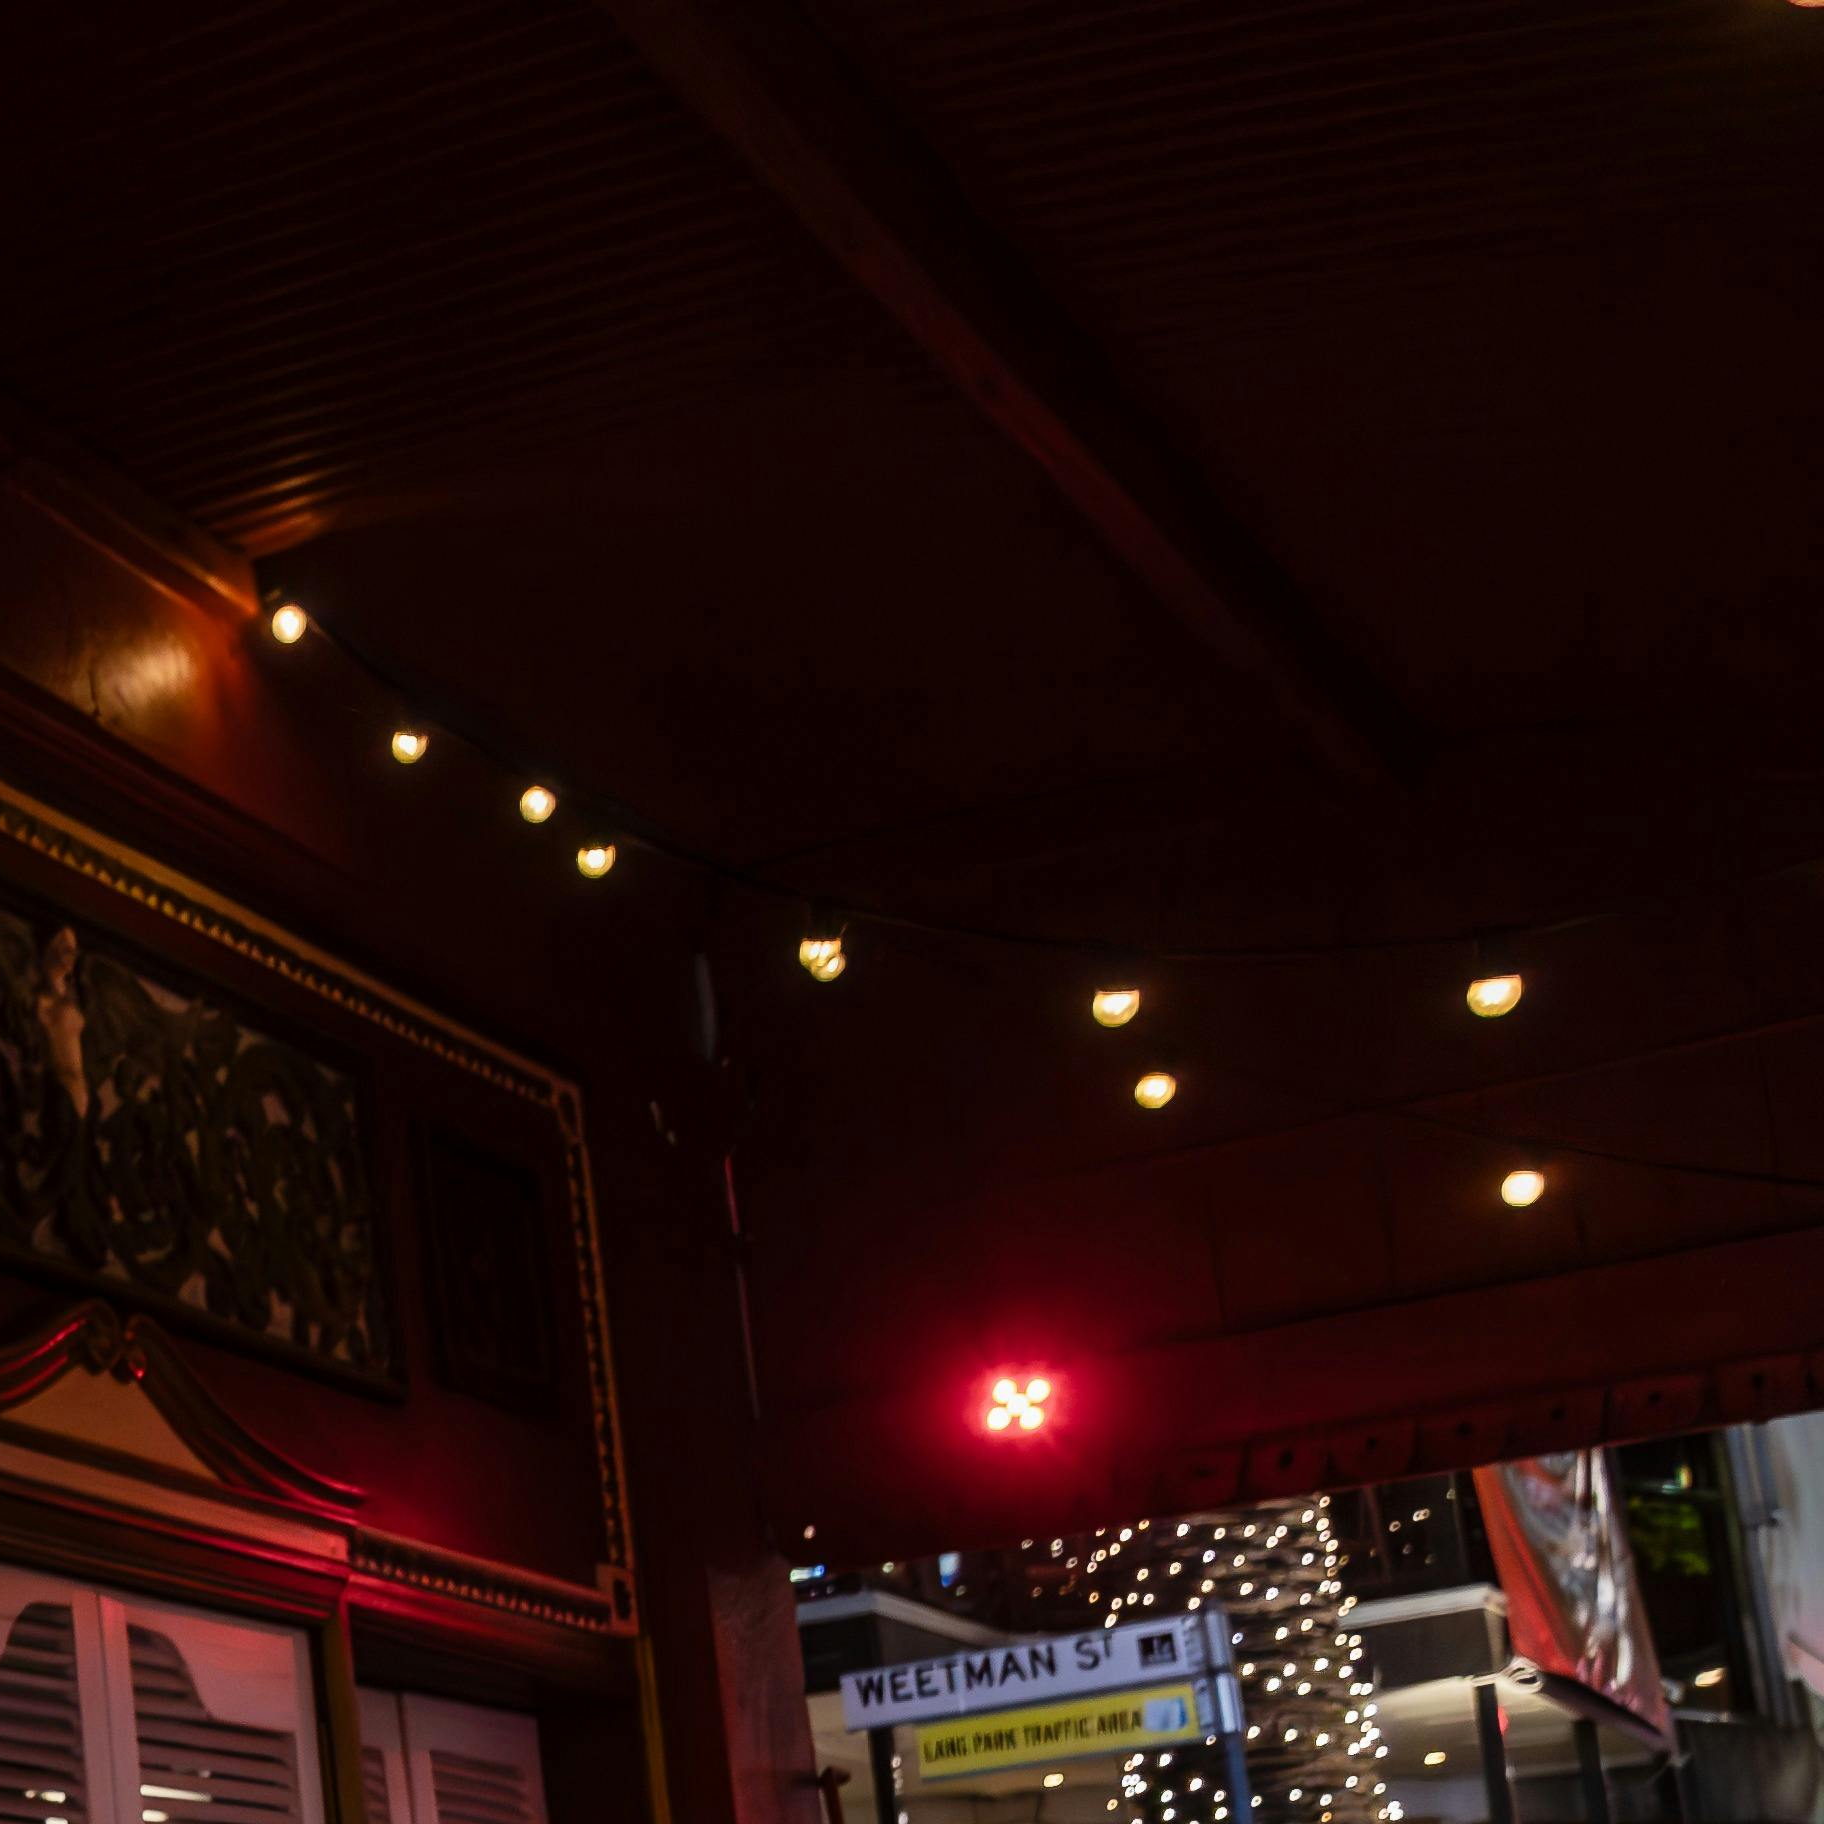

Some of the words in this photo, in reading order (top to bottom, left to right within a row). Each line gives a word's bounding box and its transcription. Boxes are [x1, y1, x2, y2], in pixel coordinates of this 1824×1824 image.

[855, 1645, 1056, 1708] WEETMAN
[973, 1730, 1017, 1755] PARK
[1022, 1718, 1089, 1746] TRAFFIC
[1096, 1710, 1142, 1736] AREA
